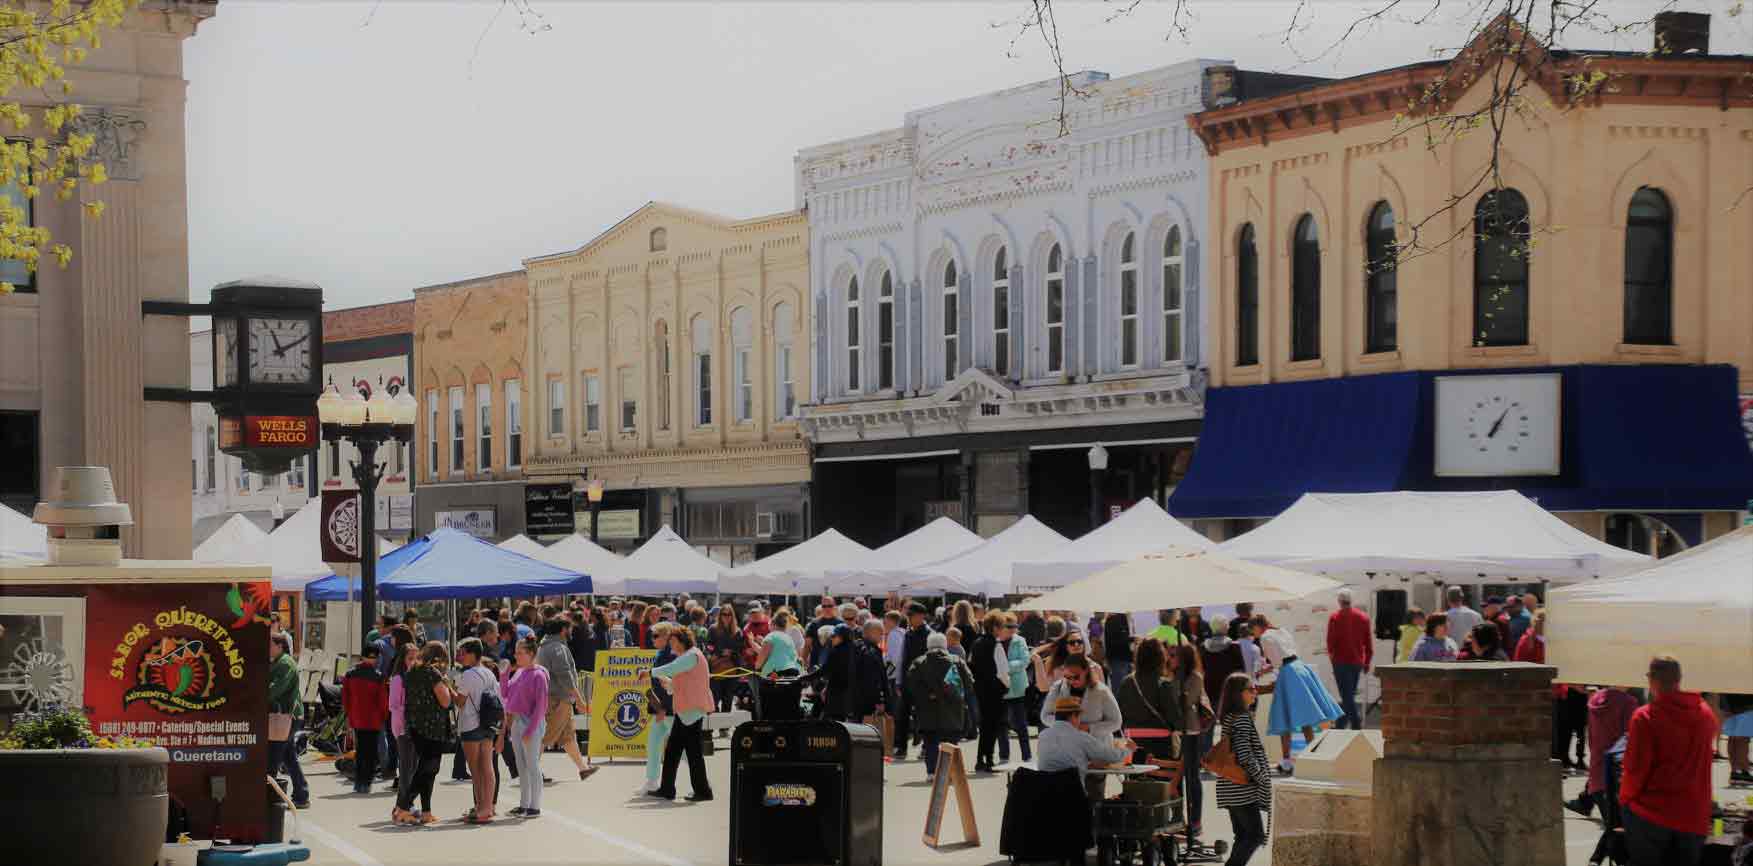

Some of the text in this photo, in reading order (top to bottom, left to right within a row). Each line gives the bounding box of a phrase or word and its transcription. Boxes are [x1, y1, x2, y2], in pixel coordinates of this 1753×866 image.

[257, 419, 306, 431] WELLS
[259, 432, 306, 442] FARGO
[111, 622, 150, 679] SABOR
[601, 667, 632, 677] Lions
[622, 704, 635, 723] L
[161, 720, 225, 734] Catering/Special
[225, 720, 250, 733] Events
[228, 735, 237, 745] WI
[173, 750, 242, 762] Queretano
